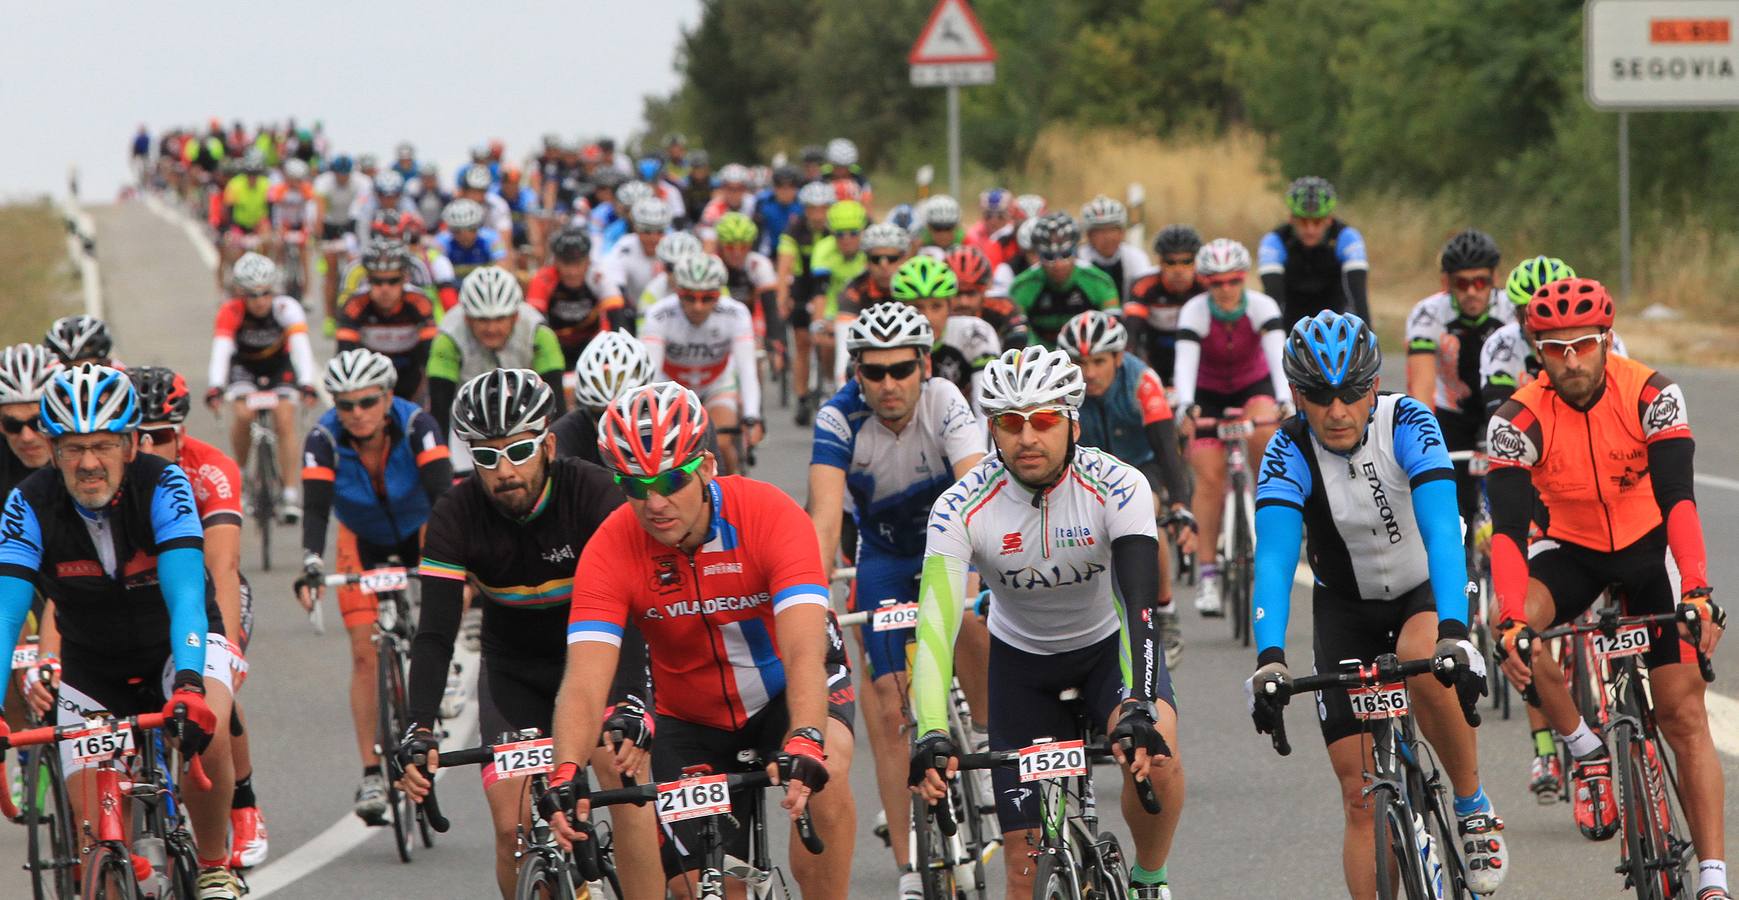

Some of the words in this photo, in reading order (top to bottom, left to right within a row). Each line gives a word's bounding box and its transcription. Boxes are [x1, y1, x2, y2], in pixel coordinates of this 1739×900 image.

[1612, 58, 1734, 81] SEGOVIA
[1362, 462, 1402, 545] ETXEONDO
[996, 561, 1106, 590] ITALIA
[665, 592, 771, 618] VILADECANS
[1594, 630, 1647, 653] 1250
[1352, 691, 1404, 713] 1656
[73, 731, 128, 757] 1657
[497, 747, 553, 771] 1259
[1021, 750, 1082, 774] 1520
[660, 783, 725, 812] 2168
